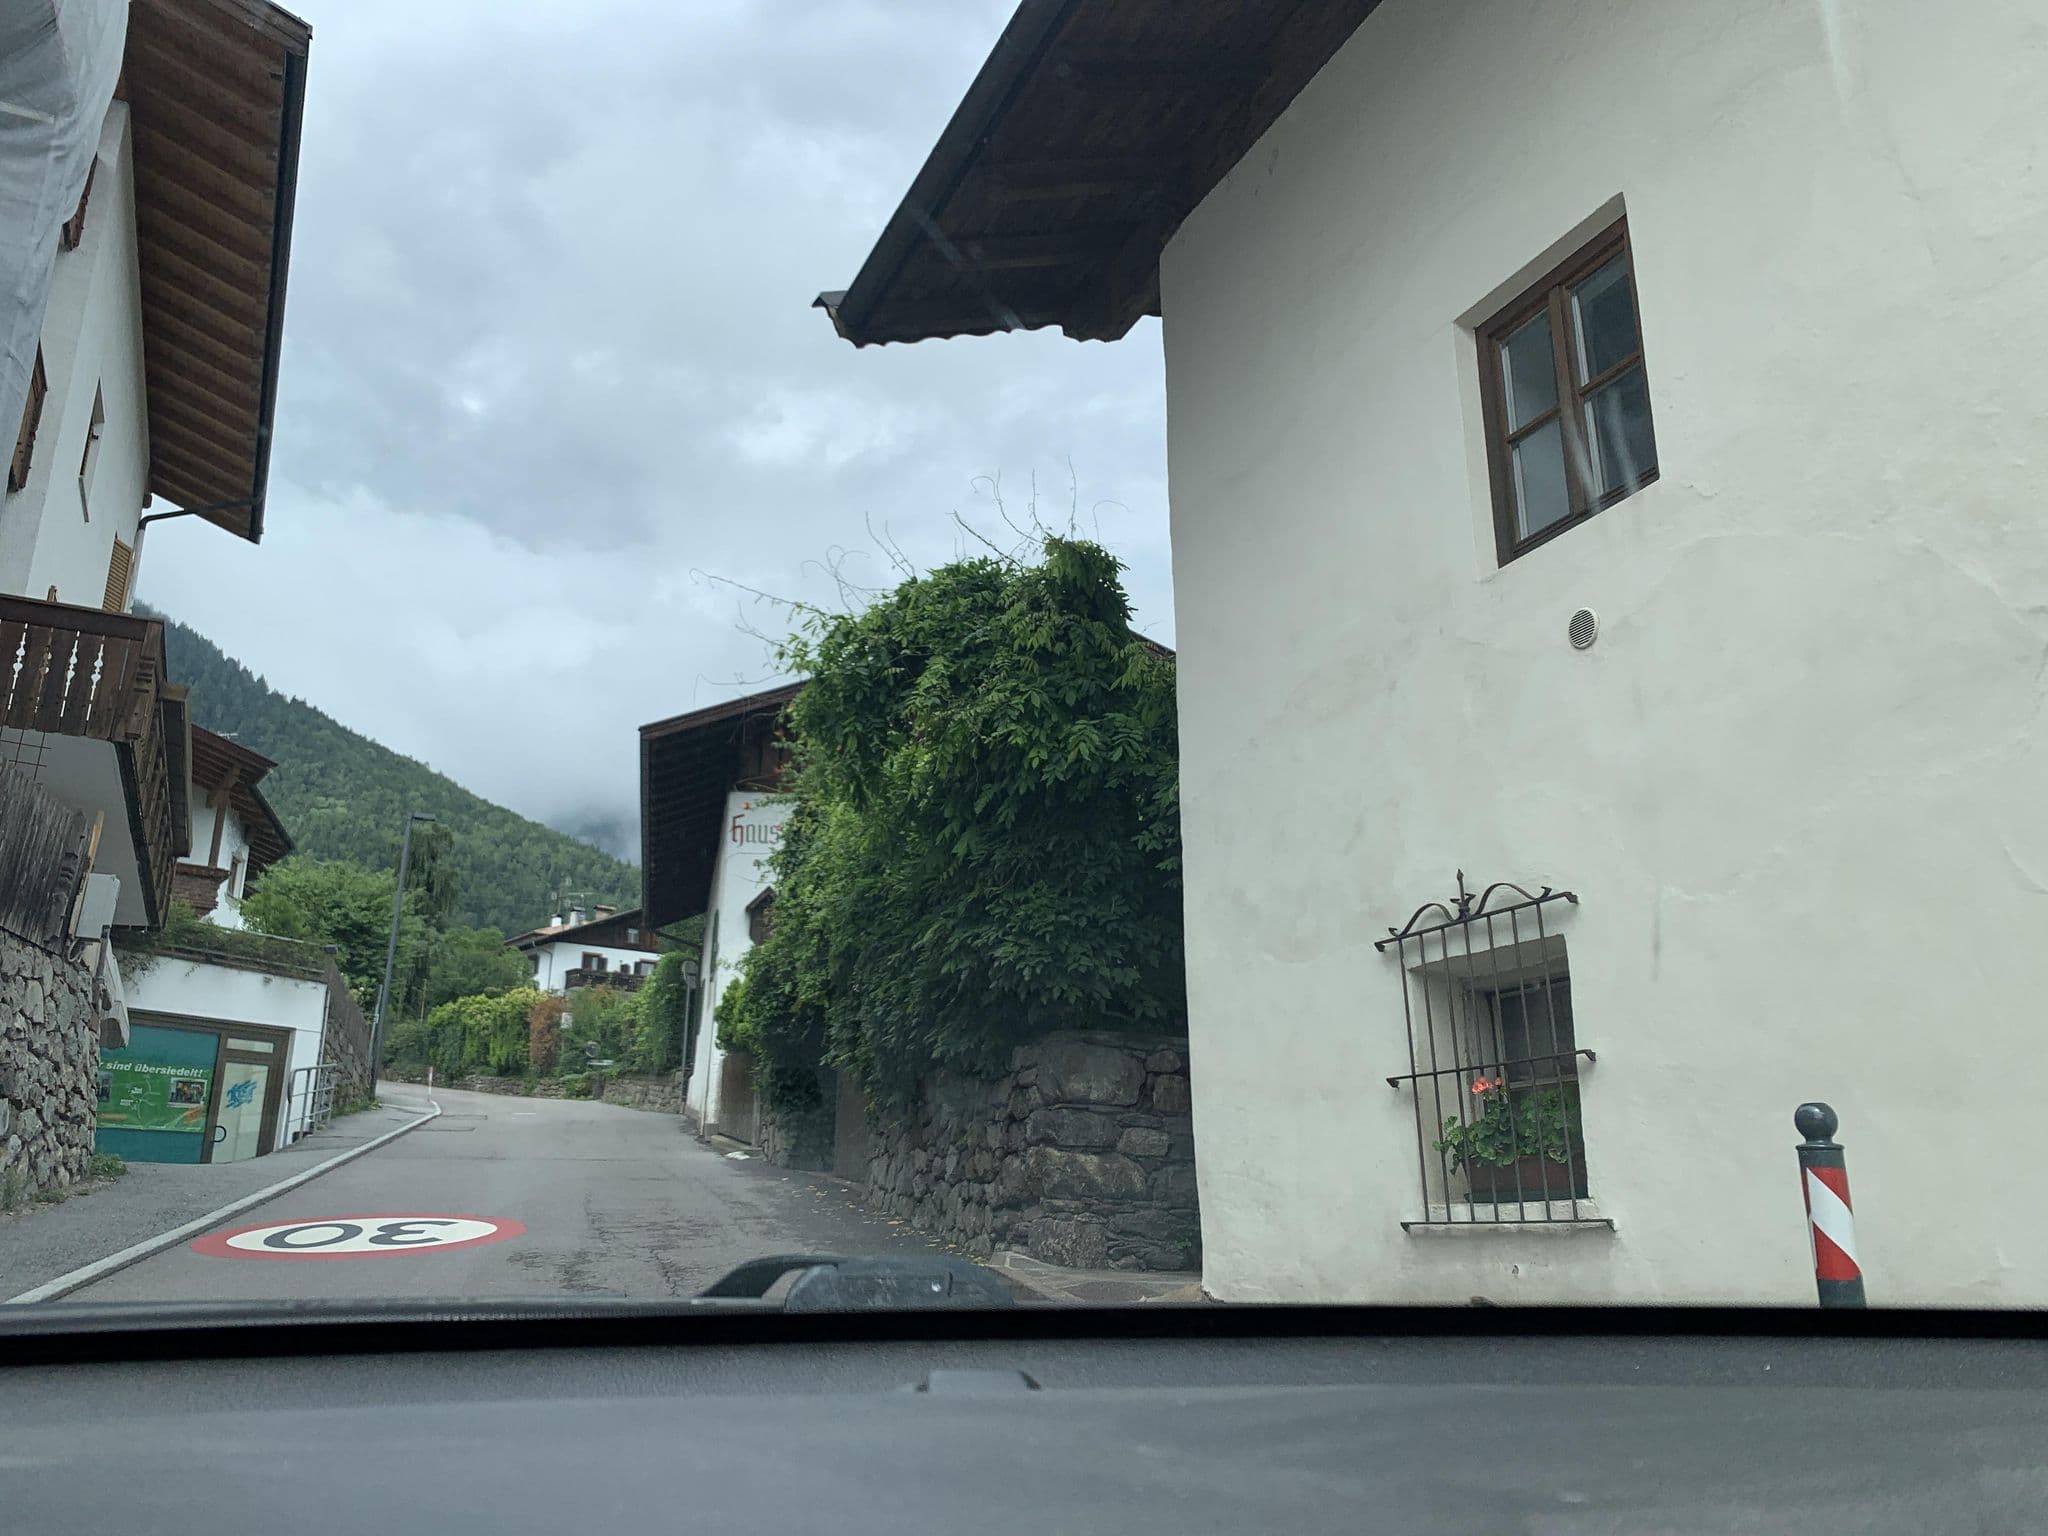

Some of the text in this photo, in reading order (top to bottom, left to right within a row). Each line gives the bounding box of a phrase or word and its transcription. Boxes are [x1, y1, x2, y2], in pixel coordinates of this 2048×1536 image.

[106, 1060, 132, 1071] sind
[134, 1063, 203, 1077] übersiedelt!
[263, 1220, 460, 1249] 30
